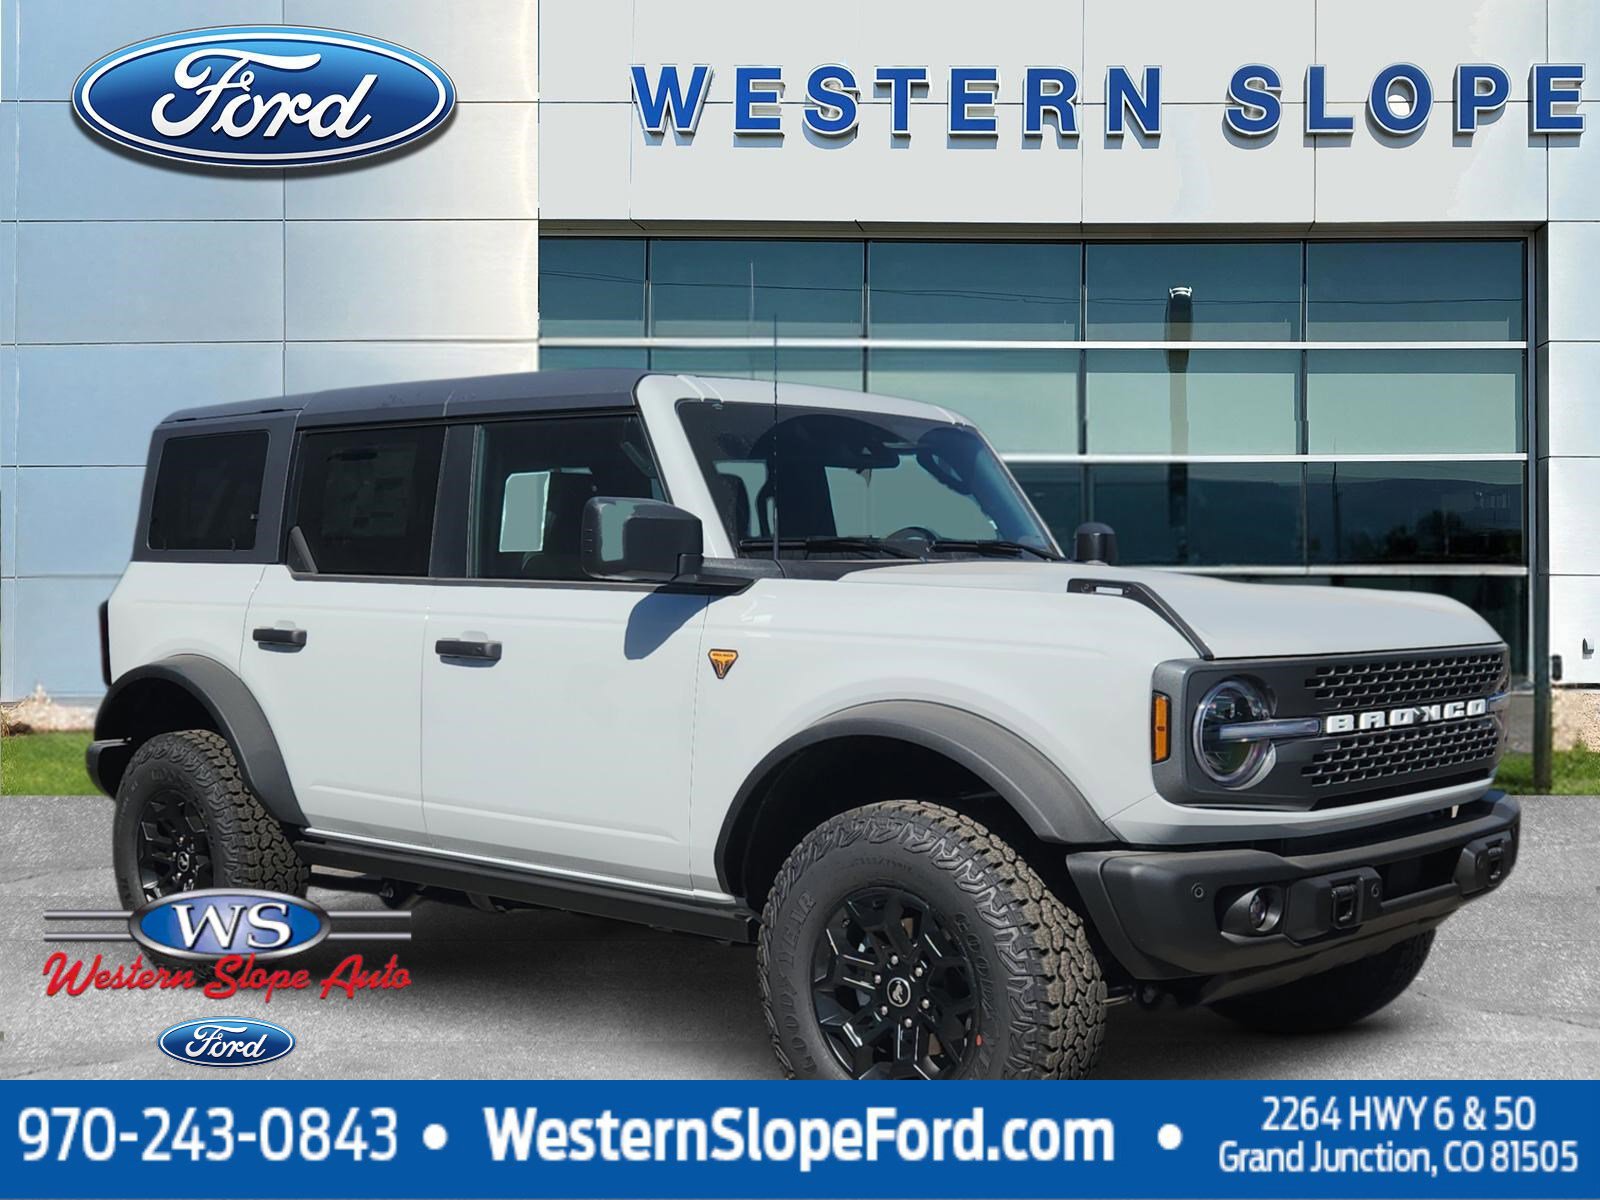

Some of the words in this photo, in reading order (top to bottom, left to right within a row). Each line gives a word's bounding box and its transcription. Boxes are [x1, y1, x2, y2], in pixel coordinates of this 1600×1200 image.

[151, 48, 377, 139] Ford
[631, 64, 1163, 137] WESTERN
[1226, 63, 1586, 136] SLOPE
[1326, 699, 1486, 733] BRONCO
